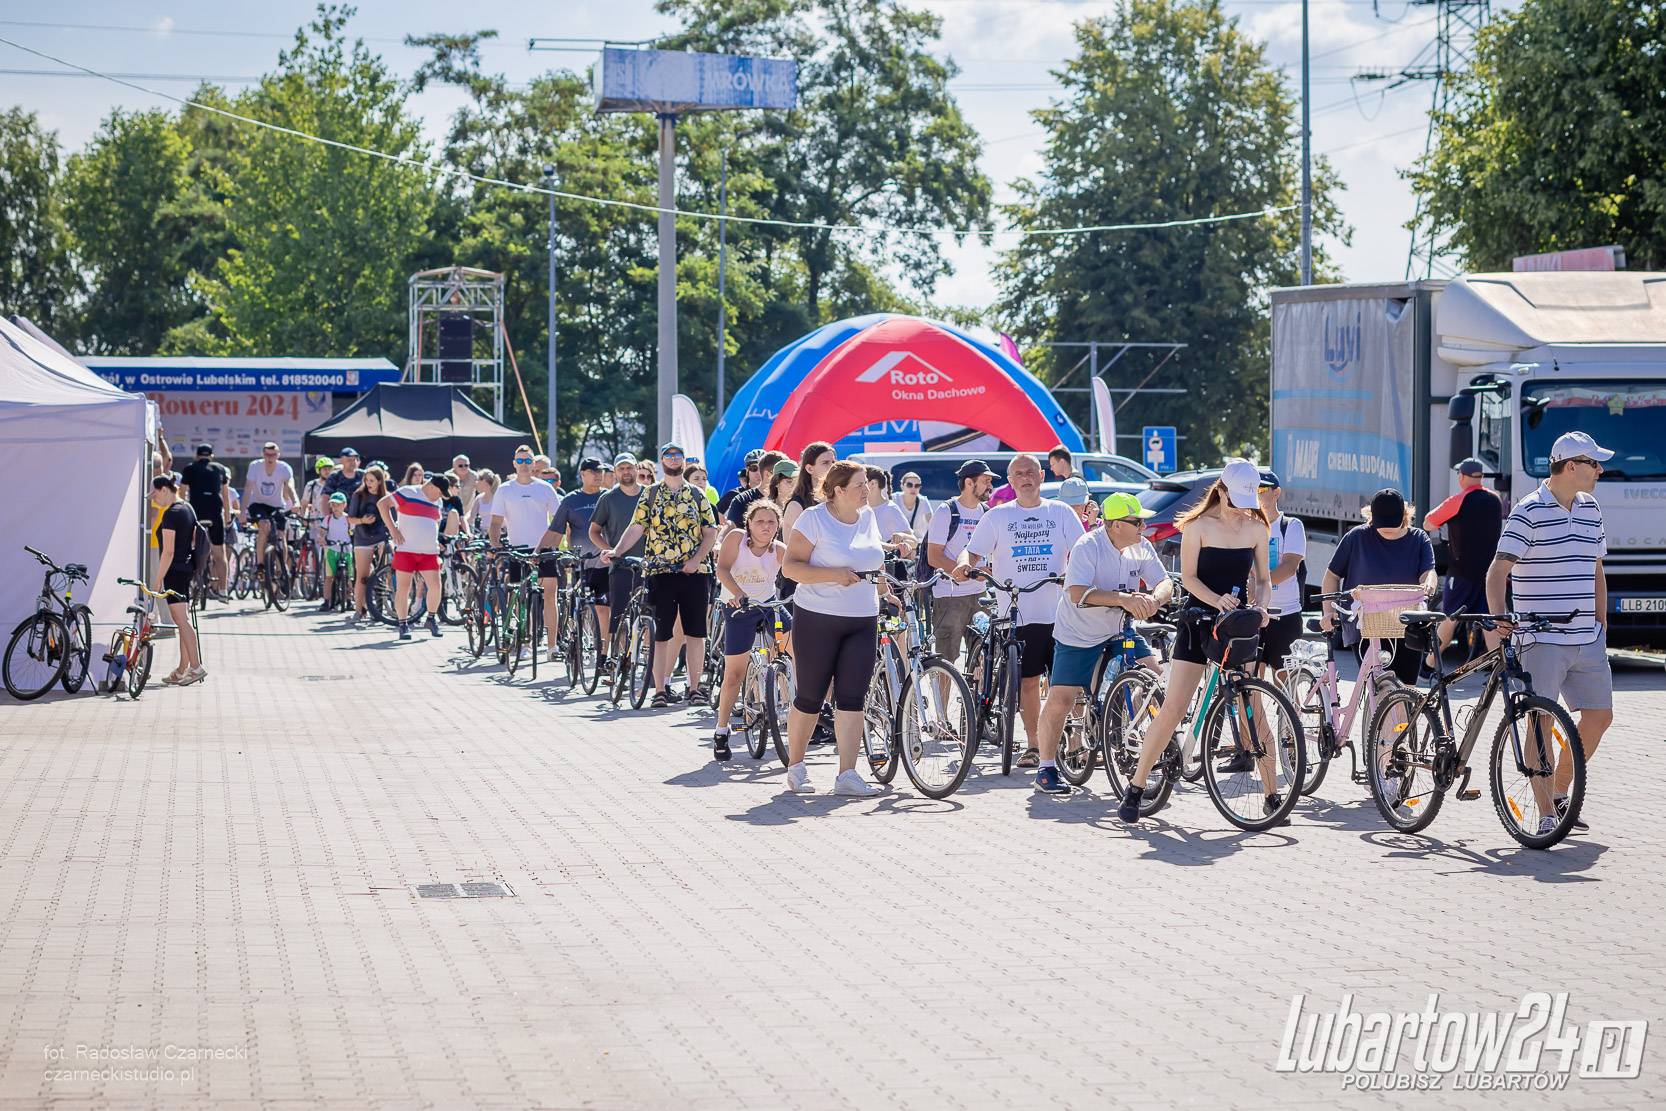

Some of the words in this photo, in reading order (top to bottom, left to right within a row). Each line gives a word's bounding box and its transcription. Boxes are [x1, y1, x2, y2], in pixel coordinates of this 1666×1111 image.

[125, 376, 136, 385] w
[140, 373, 193, 385] Ostrowie
[196, 373, 256, 386] Lubelskim
[261, 374, 280, 386] tel.
[282, 374, 344, 386] 818520040
[890, 370, 940, 385] Roto
[892, 389, 925, 400] Okna
[927, 386, 986, 400] Dachowe
[246, 394, 299, 421] 2024
[1014, 530, 1050, 540] Najlepszy
[1024, 546, 1040, 555] TATA
[1017, 563, 1048, 573] ŚWIECIE
[1622, 600, 1642, 610] LLB
[1646, 600, 1666, 610] 210
